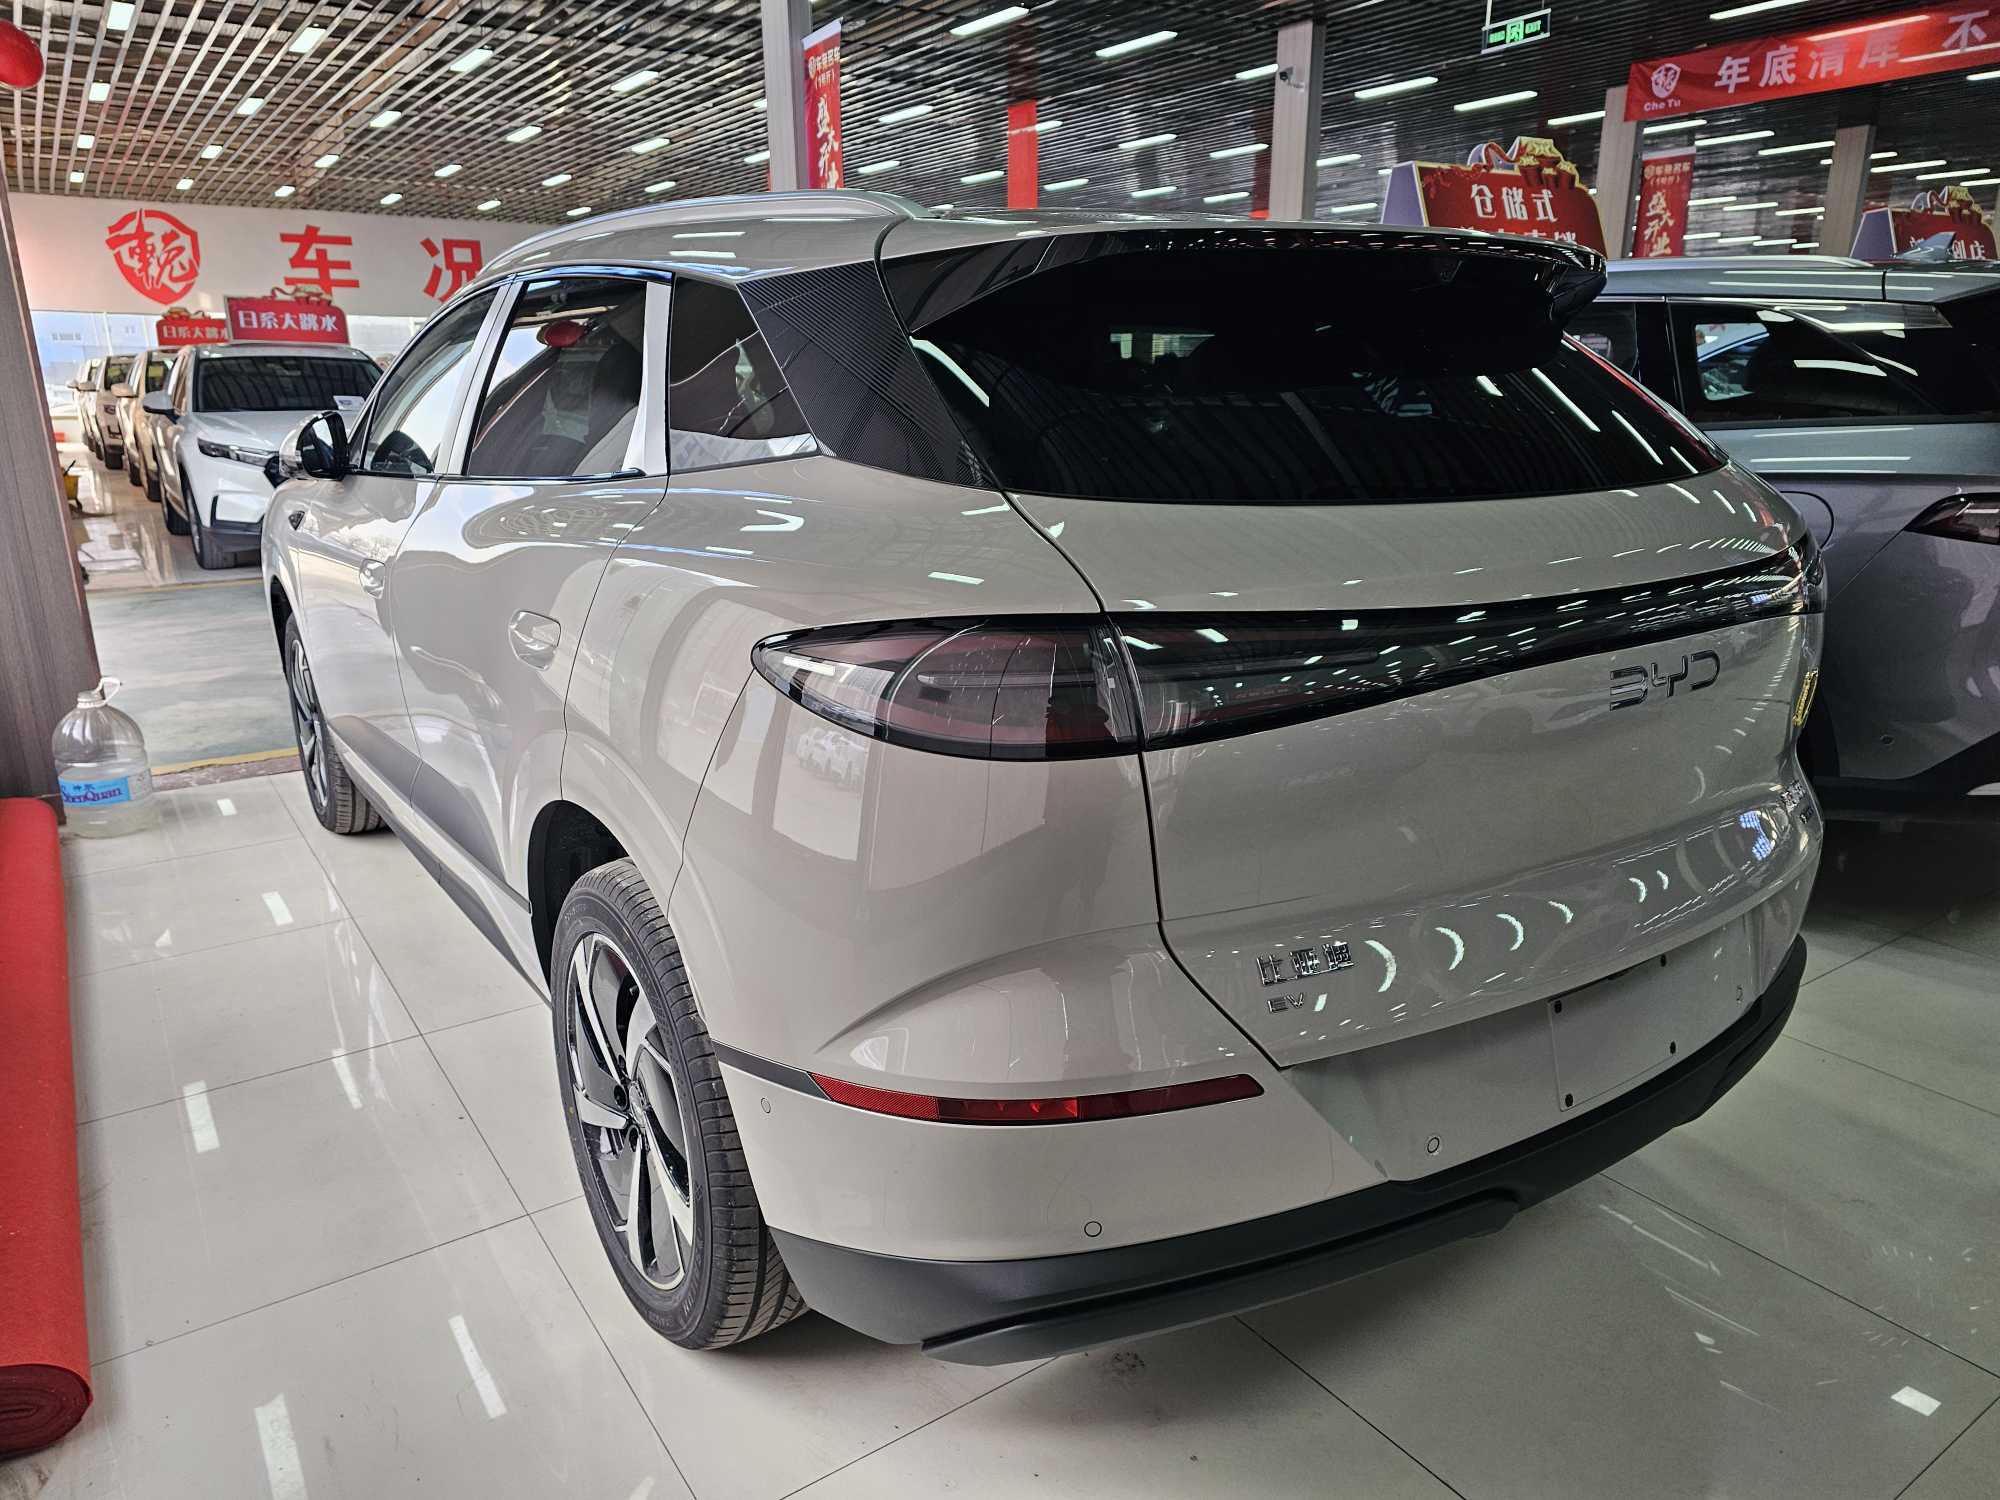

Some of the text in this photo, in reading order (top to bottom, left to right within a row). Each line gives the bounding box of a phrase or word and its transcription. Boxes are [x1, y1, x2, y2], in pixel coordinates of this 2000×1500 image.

[1714, 24, 1905, 94] 年底清库
[1942, 10, 1990, 50] 不
[1643, 98, 1681, 112] Che Tu
[1471, 183, 1558, 222] 仓储式
[238, 310, 338, 332] 日系大跳水
[1610, 650, 1721, 711] BYD
[1267, 993, 1303, 1013] EV
